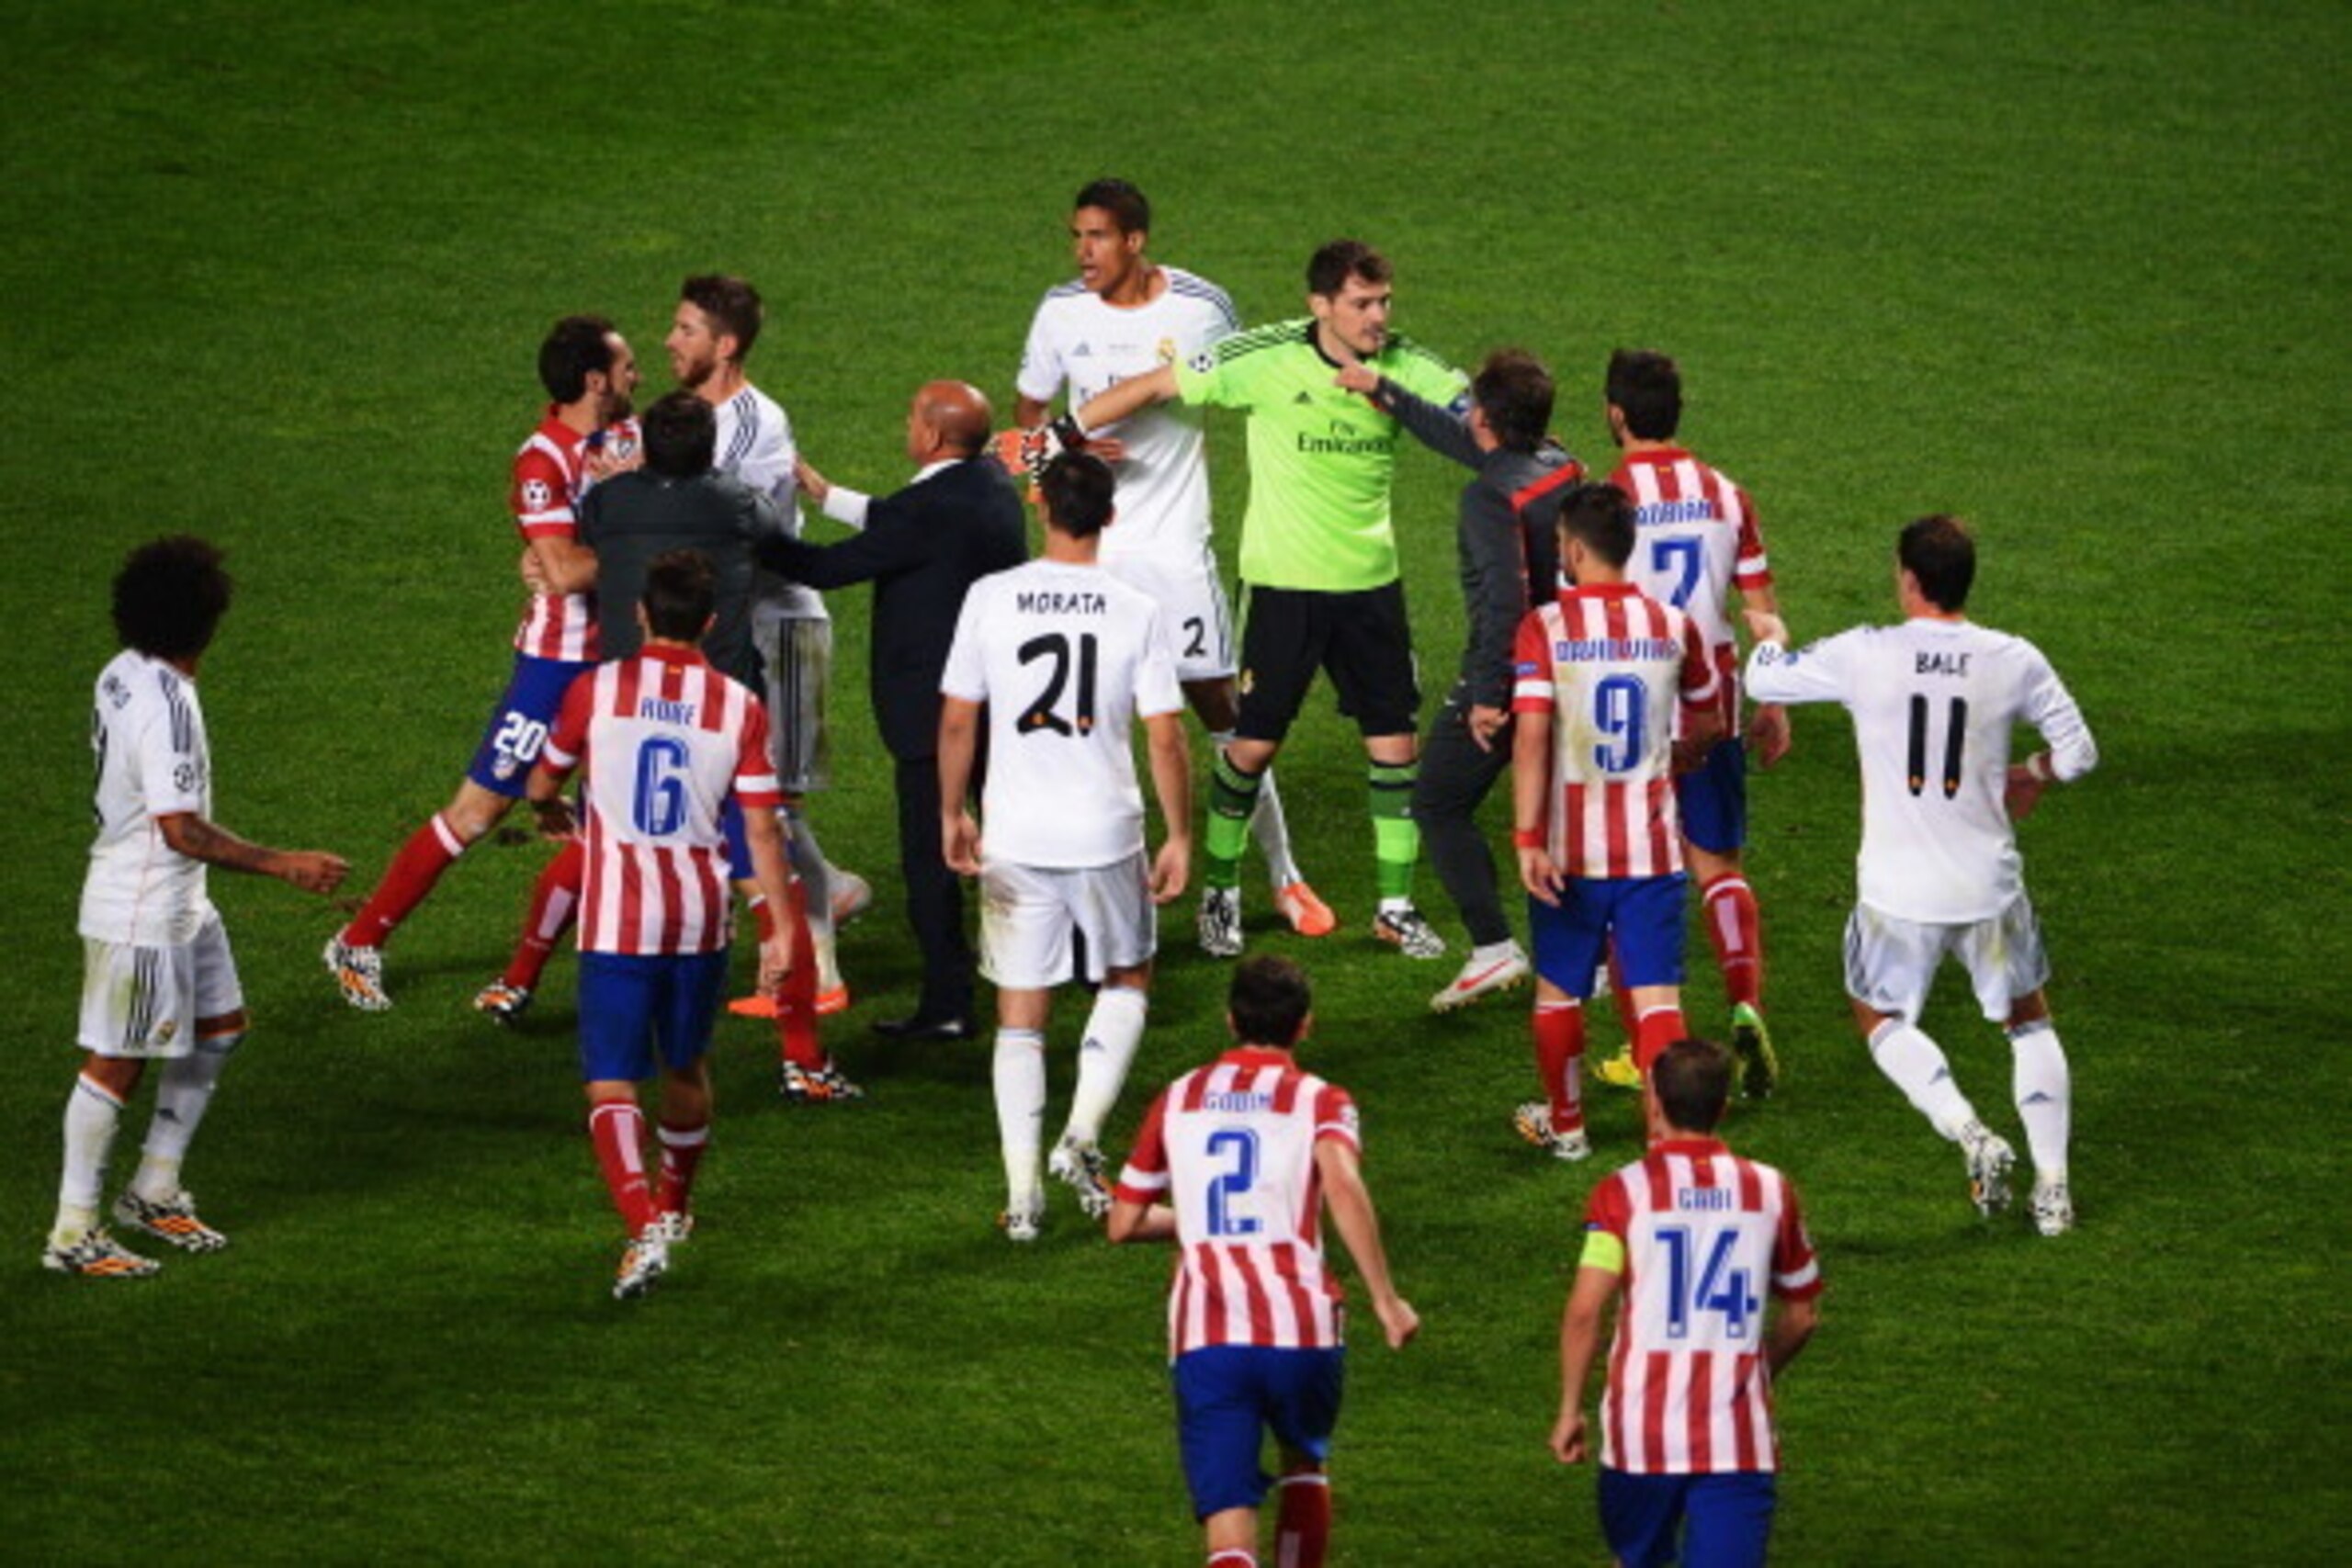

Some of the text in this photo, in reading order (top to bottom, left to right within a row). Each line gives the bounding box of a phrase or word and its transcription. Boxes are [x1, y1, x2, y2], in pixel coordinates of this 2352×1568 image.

[1016, 592, 1106, 615] MORATA
[1652, 535, 1702, 610] 7
[1182, 615, 1207, 658] 2
[1915, 650, 1973, 678] BALE
[1016, 633, 1098, 738] 21
[1595, 673, 1648, 773] 9
[494, 711, 548, 762] 20
[1907, 694, 1968, 800] 11
[633, 735, 689, 836] 6
[1205, 1125, 1264, 1236] 2
[1678, 1188, 1732, 1211] GABI
[1655, 1224, 1758, 1338] 14
